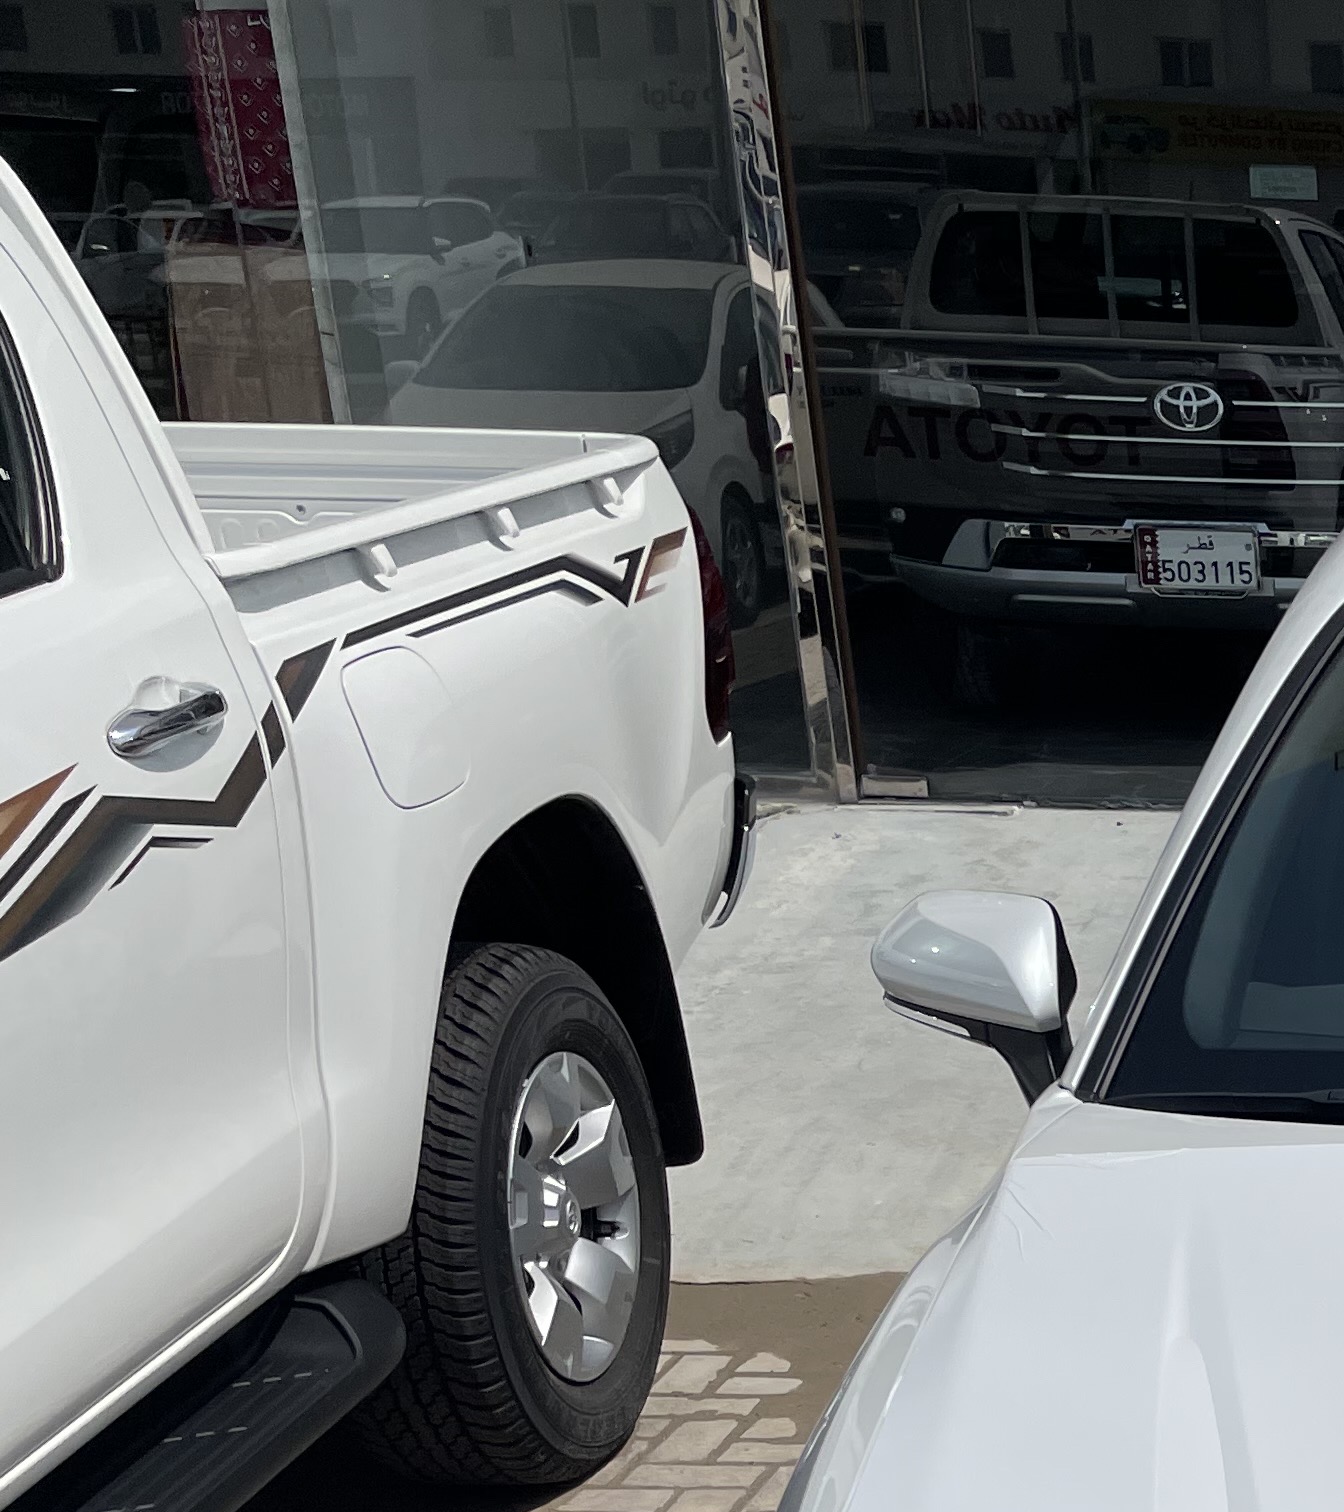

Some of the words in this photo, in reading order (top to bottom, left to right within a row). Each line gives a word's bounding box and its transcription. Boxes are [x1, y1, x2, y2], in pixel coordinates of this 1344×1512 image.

[1143, 534, 1155, 580] QATAR
[1182, 535, 1215, 555] قطر
[1161, 559, 1253, 585] 503115
